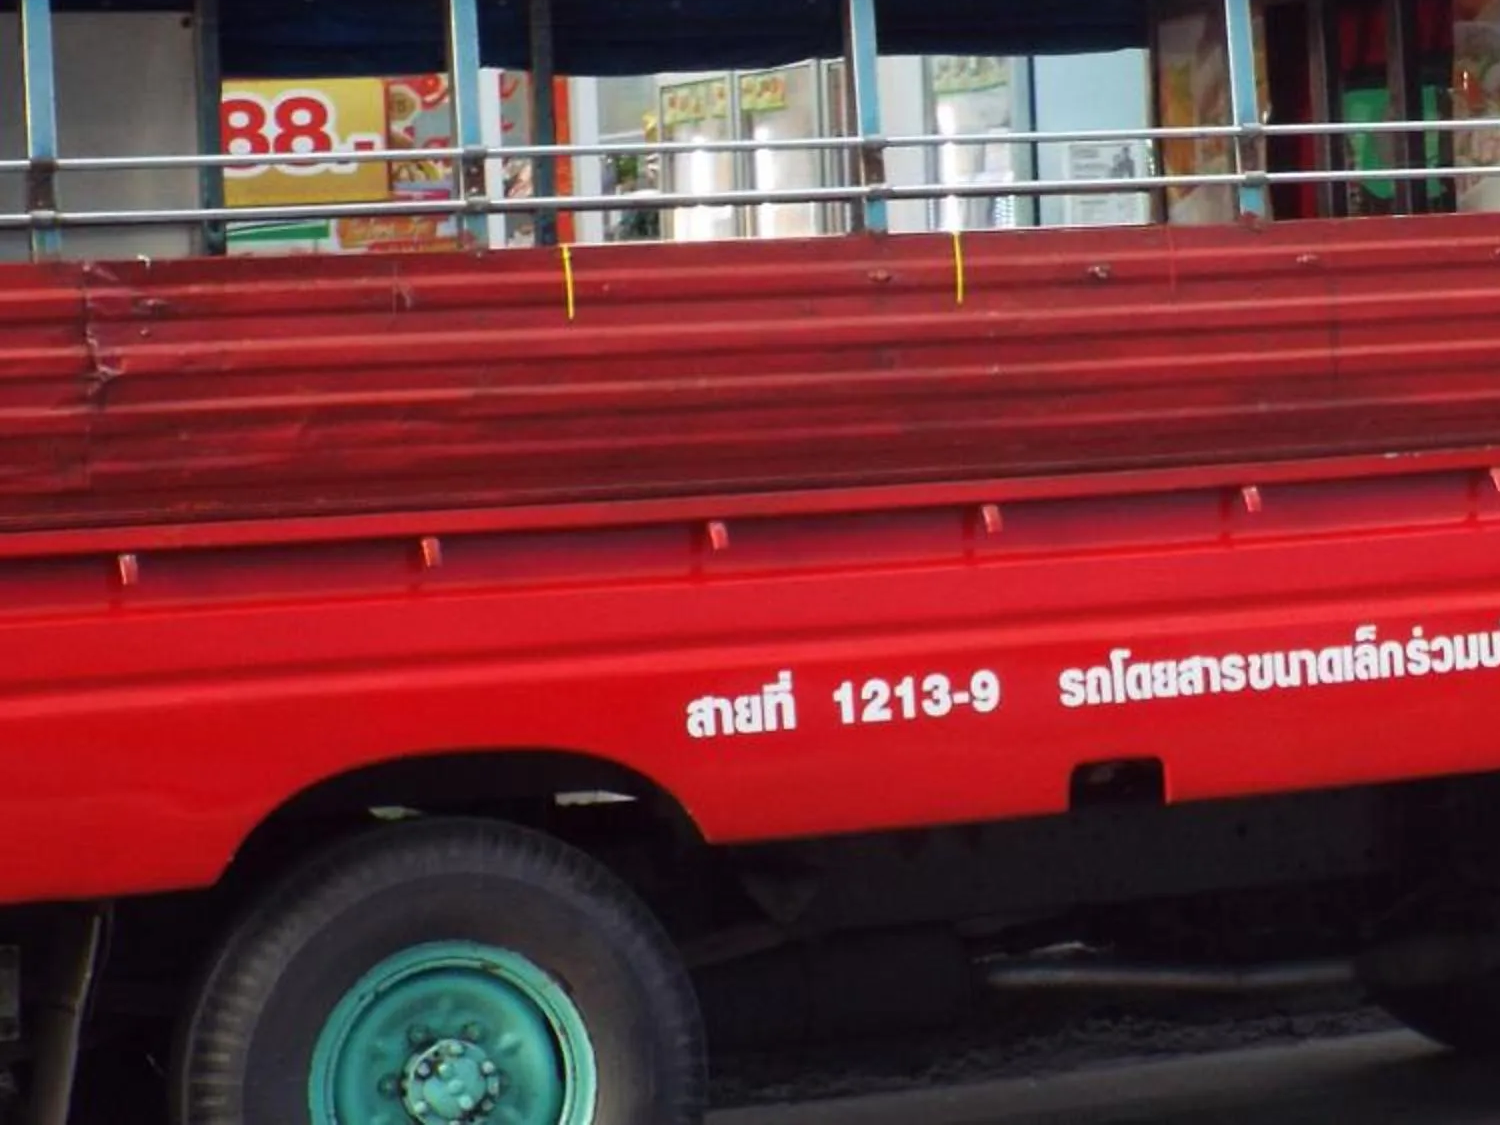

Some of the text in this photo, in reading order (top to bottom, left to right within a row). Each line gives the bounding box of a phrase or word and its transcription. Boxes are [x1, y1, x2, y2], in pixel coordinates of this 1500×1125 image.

[685, 671, 798, 739] สายที่
[832, 671, 1001, 726] 1213-9
